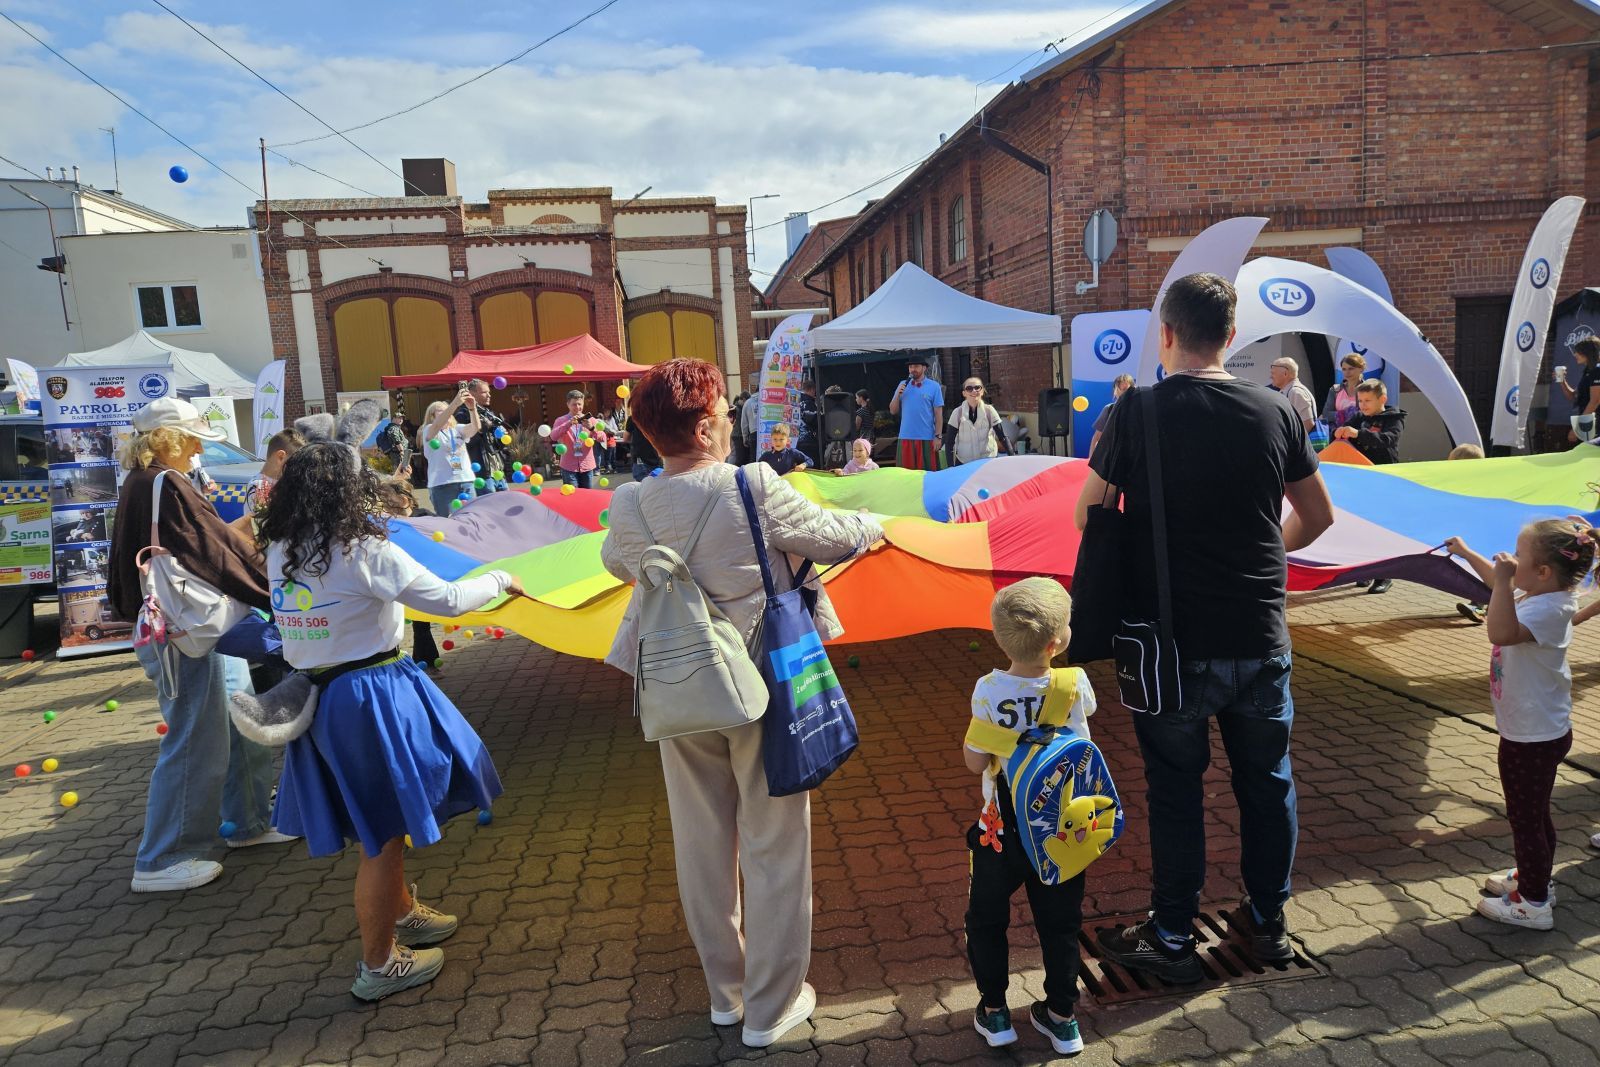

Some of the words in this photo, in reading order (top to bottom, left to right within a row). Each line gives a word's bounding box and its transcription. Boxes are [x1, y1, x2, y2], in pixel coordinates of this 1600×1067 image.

[1271, 287, 1302, 304] PZU
[1102, 339, 1123, 354] PZU
[94, 386, 126, 399] 986
[60, 402, 147, 415] PATROL-EK
[10, 530, 50, 541] Sarna
[29, 571, 51, 580] 986
[287, 616, 303, 627] 296
[305, 617, 329, 628] 506
[1030, 755, 1071, 812] PKÉN
